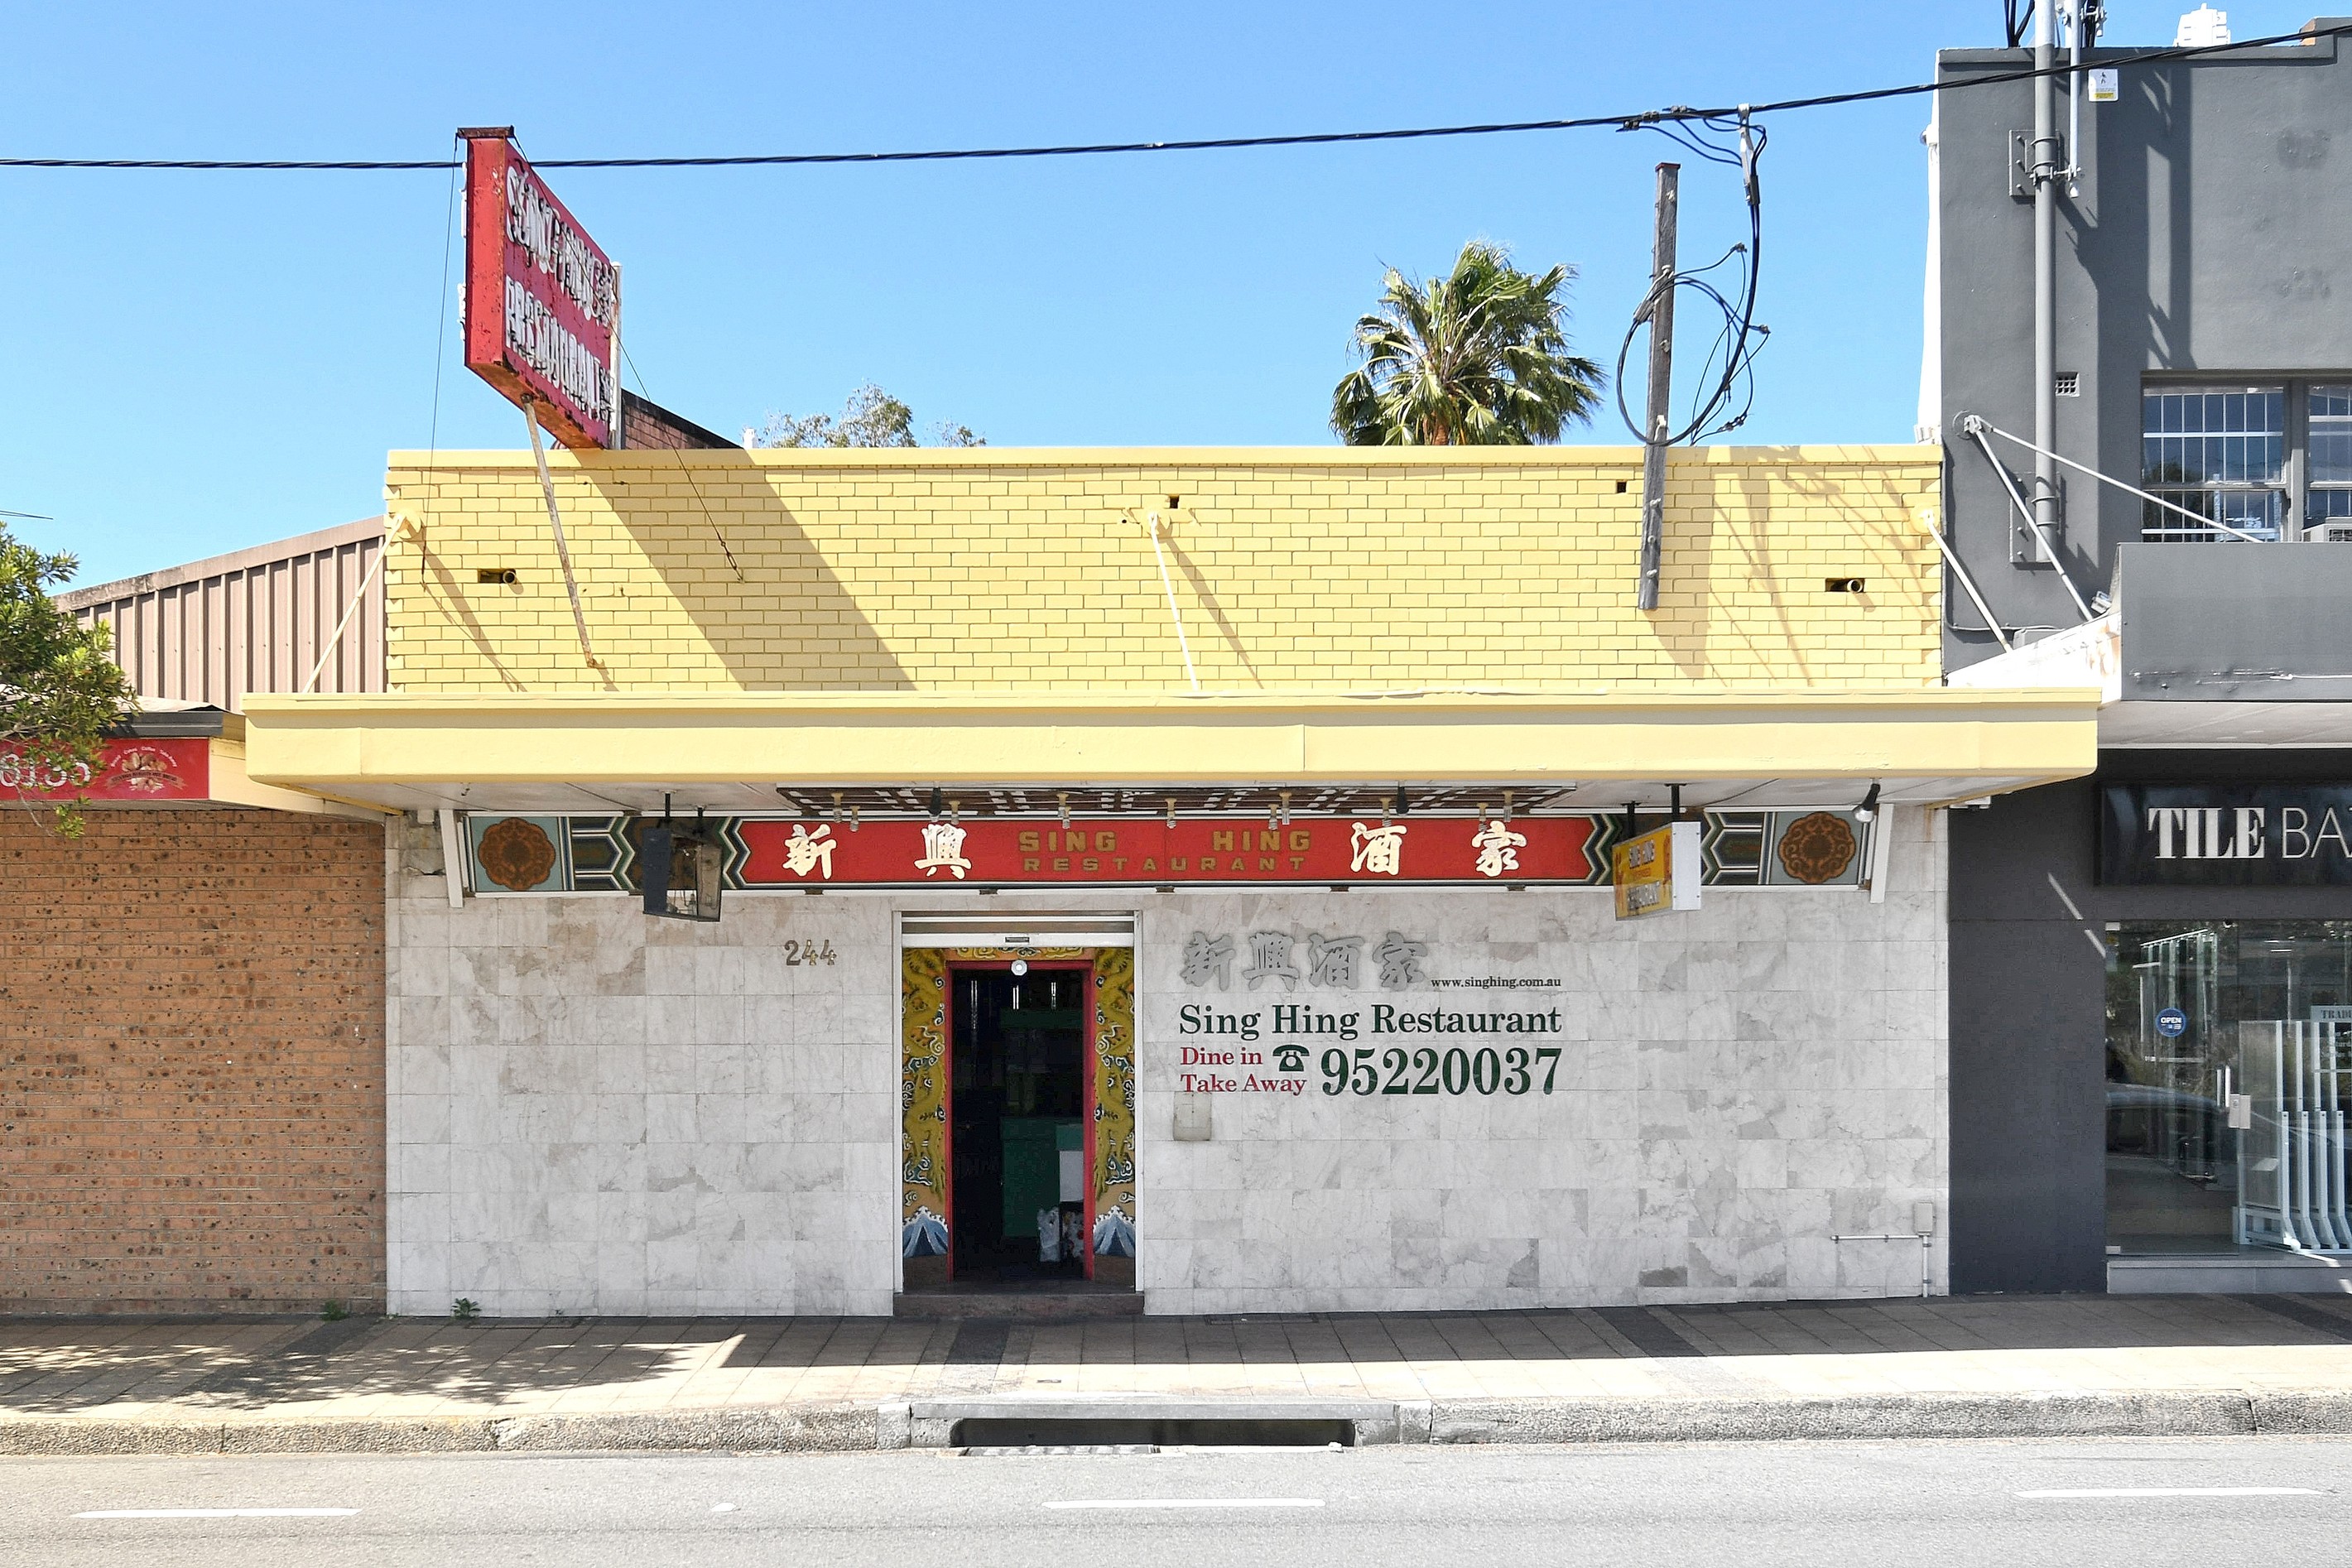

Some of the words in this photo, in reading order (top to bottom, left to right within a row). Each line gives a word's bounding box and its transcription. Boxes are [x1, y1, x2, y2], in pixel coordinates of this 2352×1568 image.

[1018, 830, 1117, 852] SING
[1213, 830, 1311, 852] HING
[2148, 807, 2265, 859] TILE
[2282, 807, 2352, 859] BA
[1023, 858, 1305, 871] RESTAURANT
[784, 939, 838, 966] 244
[1431, 976, 1562, 989] www.singhing.com.au
[1179, 1004, 1261, 1041] Sing
[1272, 1004, 1360, 1041] Hing
[1371, 1004, 1563, 1034] Restaurant
[1180, 1046, 1234, 1065] Dine
[1240, 1046, 1263, 1065] in
[1321, 1047, 1562, 1096] 95220037
[1180, 1074, 1237, 1094] Take
[1242, 1074, 1307, 1096] Away
